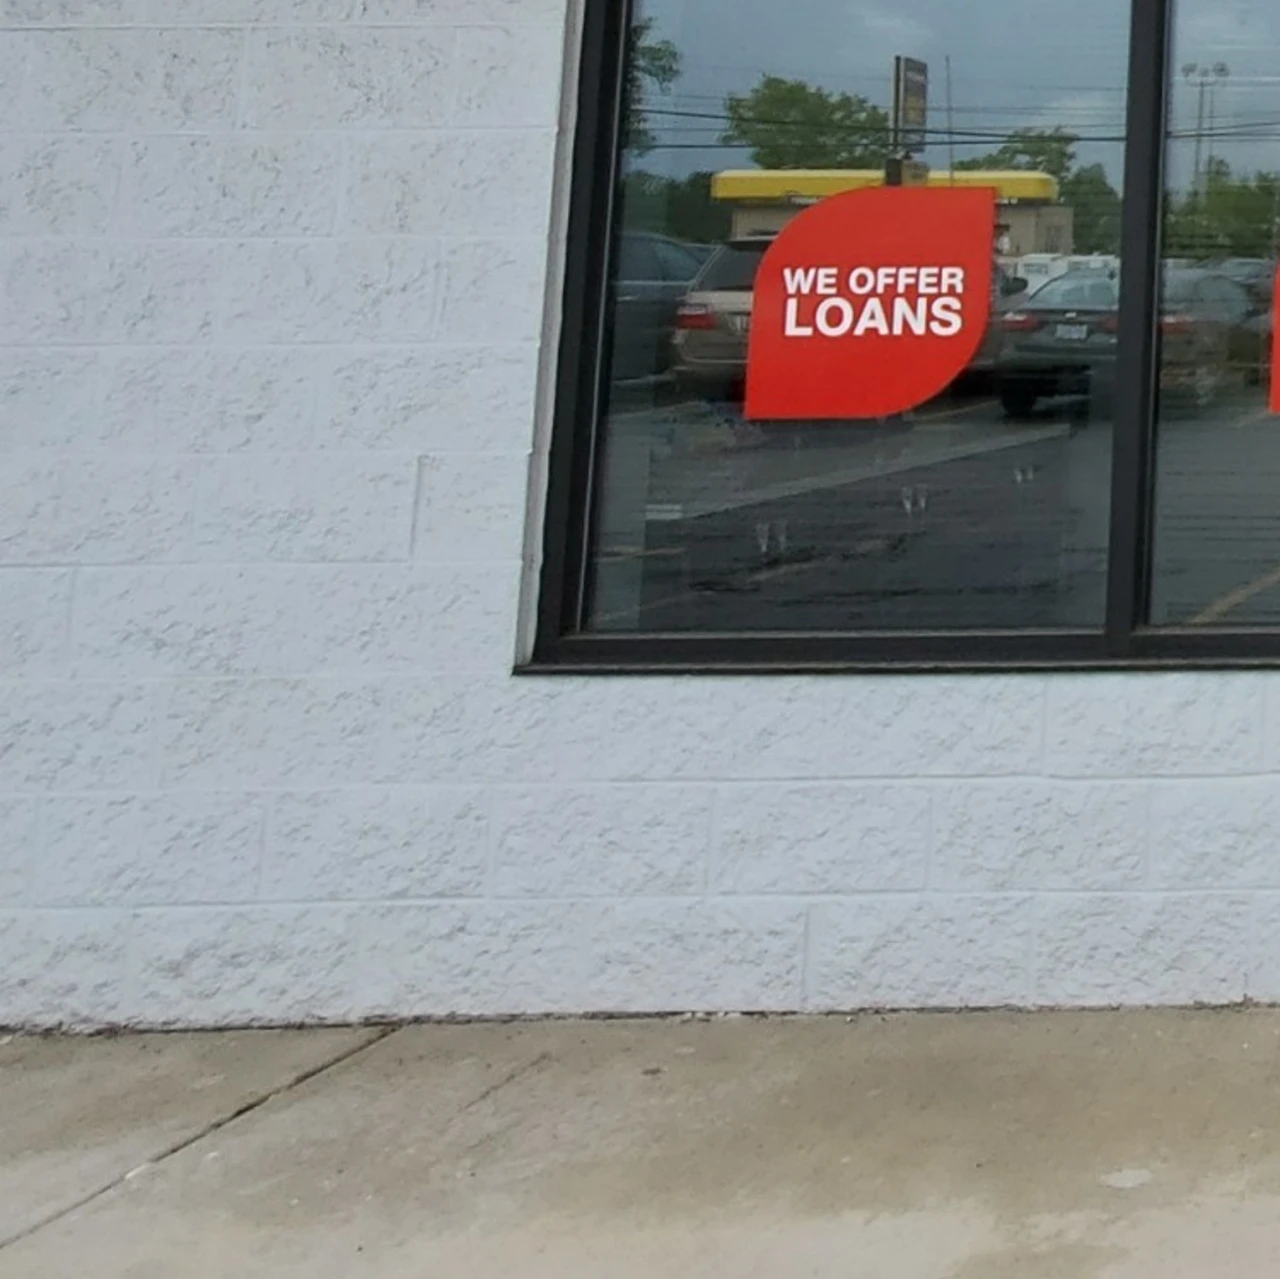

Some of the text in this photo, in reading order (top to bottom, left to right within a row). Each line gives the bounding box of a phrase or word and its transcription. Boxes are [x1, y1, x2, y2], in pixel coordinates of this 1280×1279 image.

[783, 266, 965, 294] WE OFFER
[784, 296, 963, 337] LOANS
